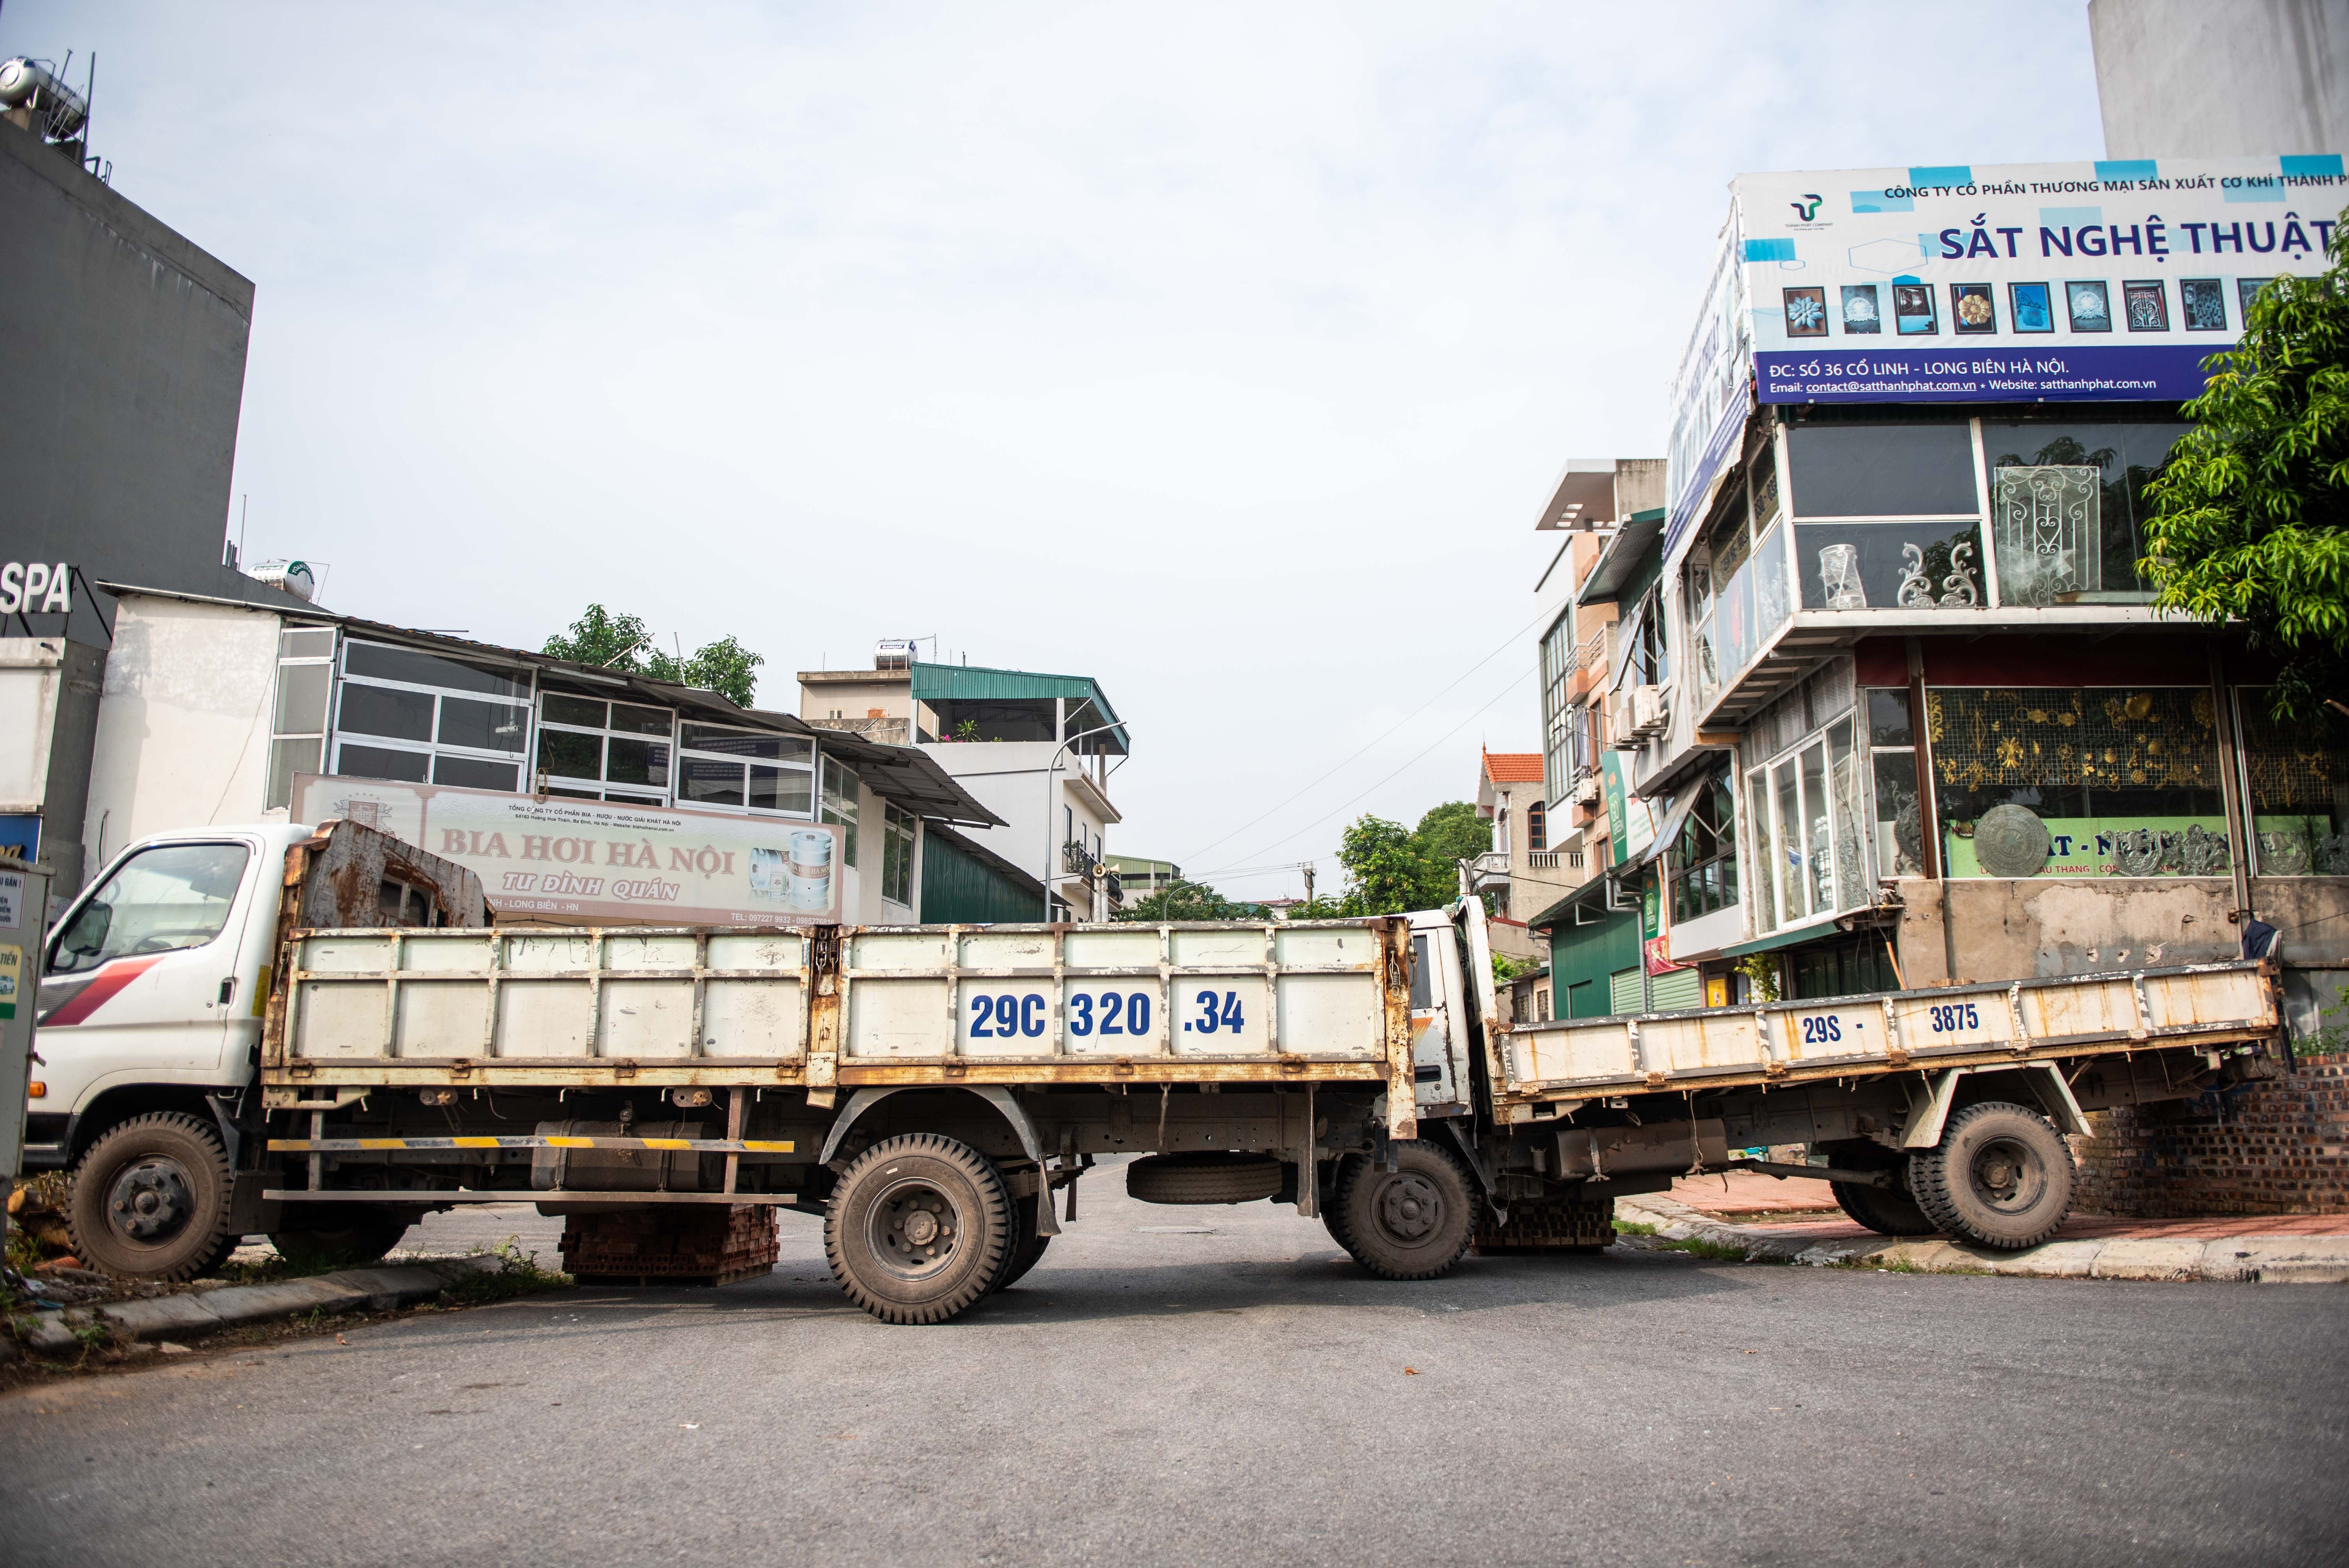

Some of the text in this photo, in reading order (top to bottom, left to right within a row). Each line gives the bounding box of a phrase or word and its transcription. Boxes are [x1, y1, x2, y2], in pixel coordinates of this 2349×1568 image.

[1884, 185, 1929, 198] CÔNG
[1932, 186, 1952, 196] TY
[1956, 181, 1977, 196] CỔ
[1982, 179, 2026, 195] PHẦN
[2030, 181, 2099, 193] THƯƠNG
[2104, 180, 2134, 193] MẠI
[2140, 176, 2170, 190] SẢN
[2175, 173, 2216, 189] XUẤT
[2221, 176, 2243, 188] CƠ
[2247, 173, 2274, 187] KHÍ
[2277, 173, 2334, 187] THÀNH
[1939, 211, 2337, 263] SẮT NGHỆ THUẬT
[1769, 365, 1795, 377] ĐC:
[1799, 359, 1820, 376] SỐ
[1825, 364, 1843, 376] 36
[1846, 358, 1869, 375] CỔ
[1873, 363, 1909, 375] LINH
[1924, 362, 1968, 374] LONG
[1972, 359, 2005, 374] BIÊN
[2010, 358, 2032, 374] HÀ
[2037, 358, 2069, 375] NỘI.
[1770, 379, 2157, 394] Email: contact@satthanhphat.com.vn Website: satthanhphat.com.vn
[0, 562, 68, 613] SPA
[440, 828, 735, 880] BIA HƠI HÀ NỘI
[2055, 865, 2090, 873] THANG
[503, 870, 681, 902] TƯ ĐÌNH QUÁN
[537, 900, 557, 910] BIÊN
[749, 914, 773, 922] 097227
[775, 915, 791, 923] 9932
[970, 991, 1244, 1038] 29C 320 .34
[1803, 1015, 1841, 1043] 29S
[1930, 1003, 1979, 1032] 3875
